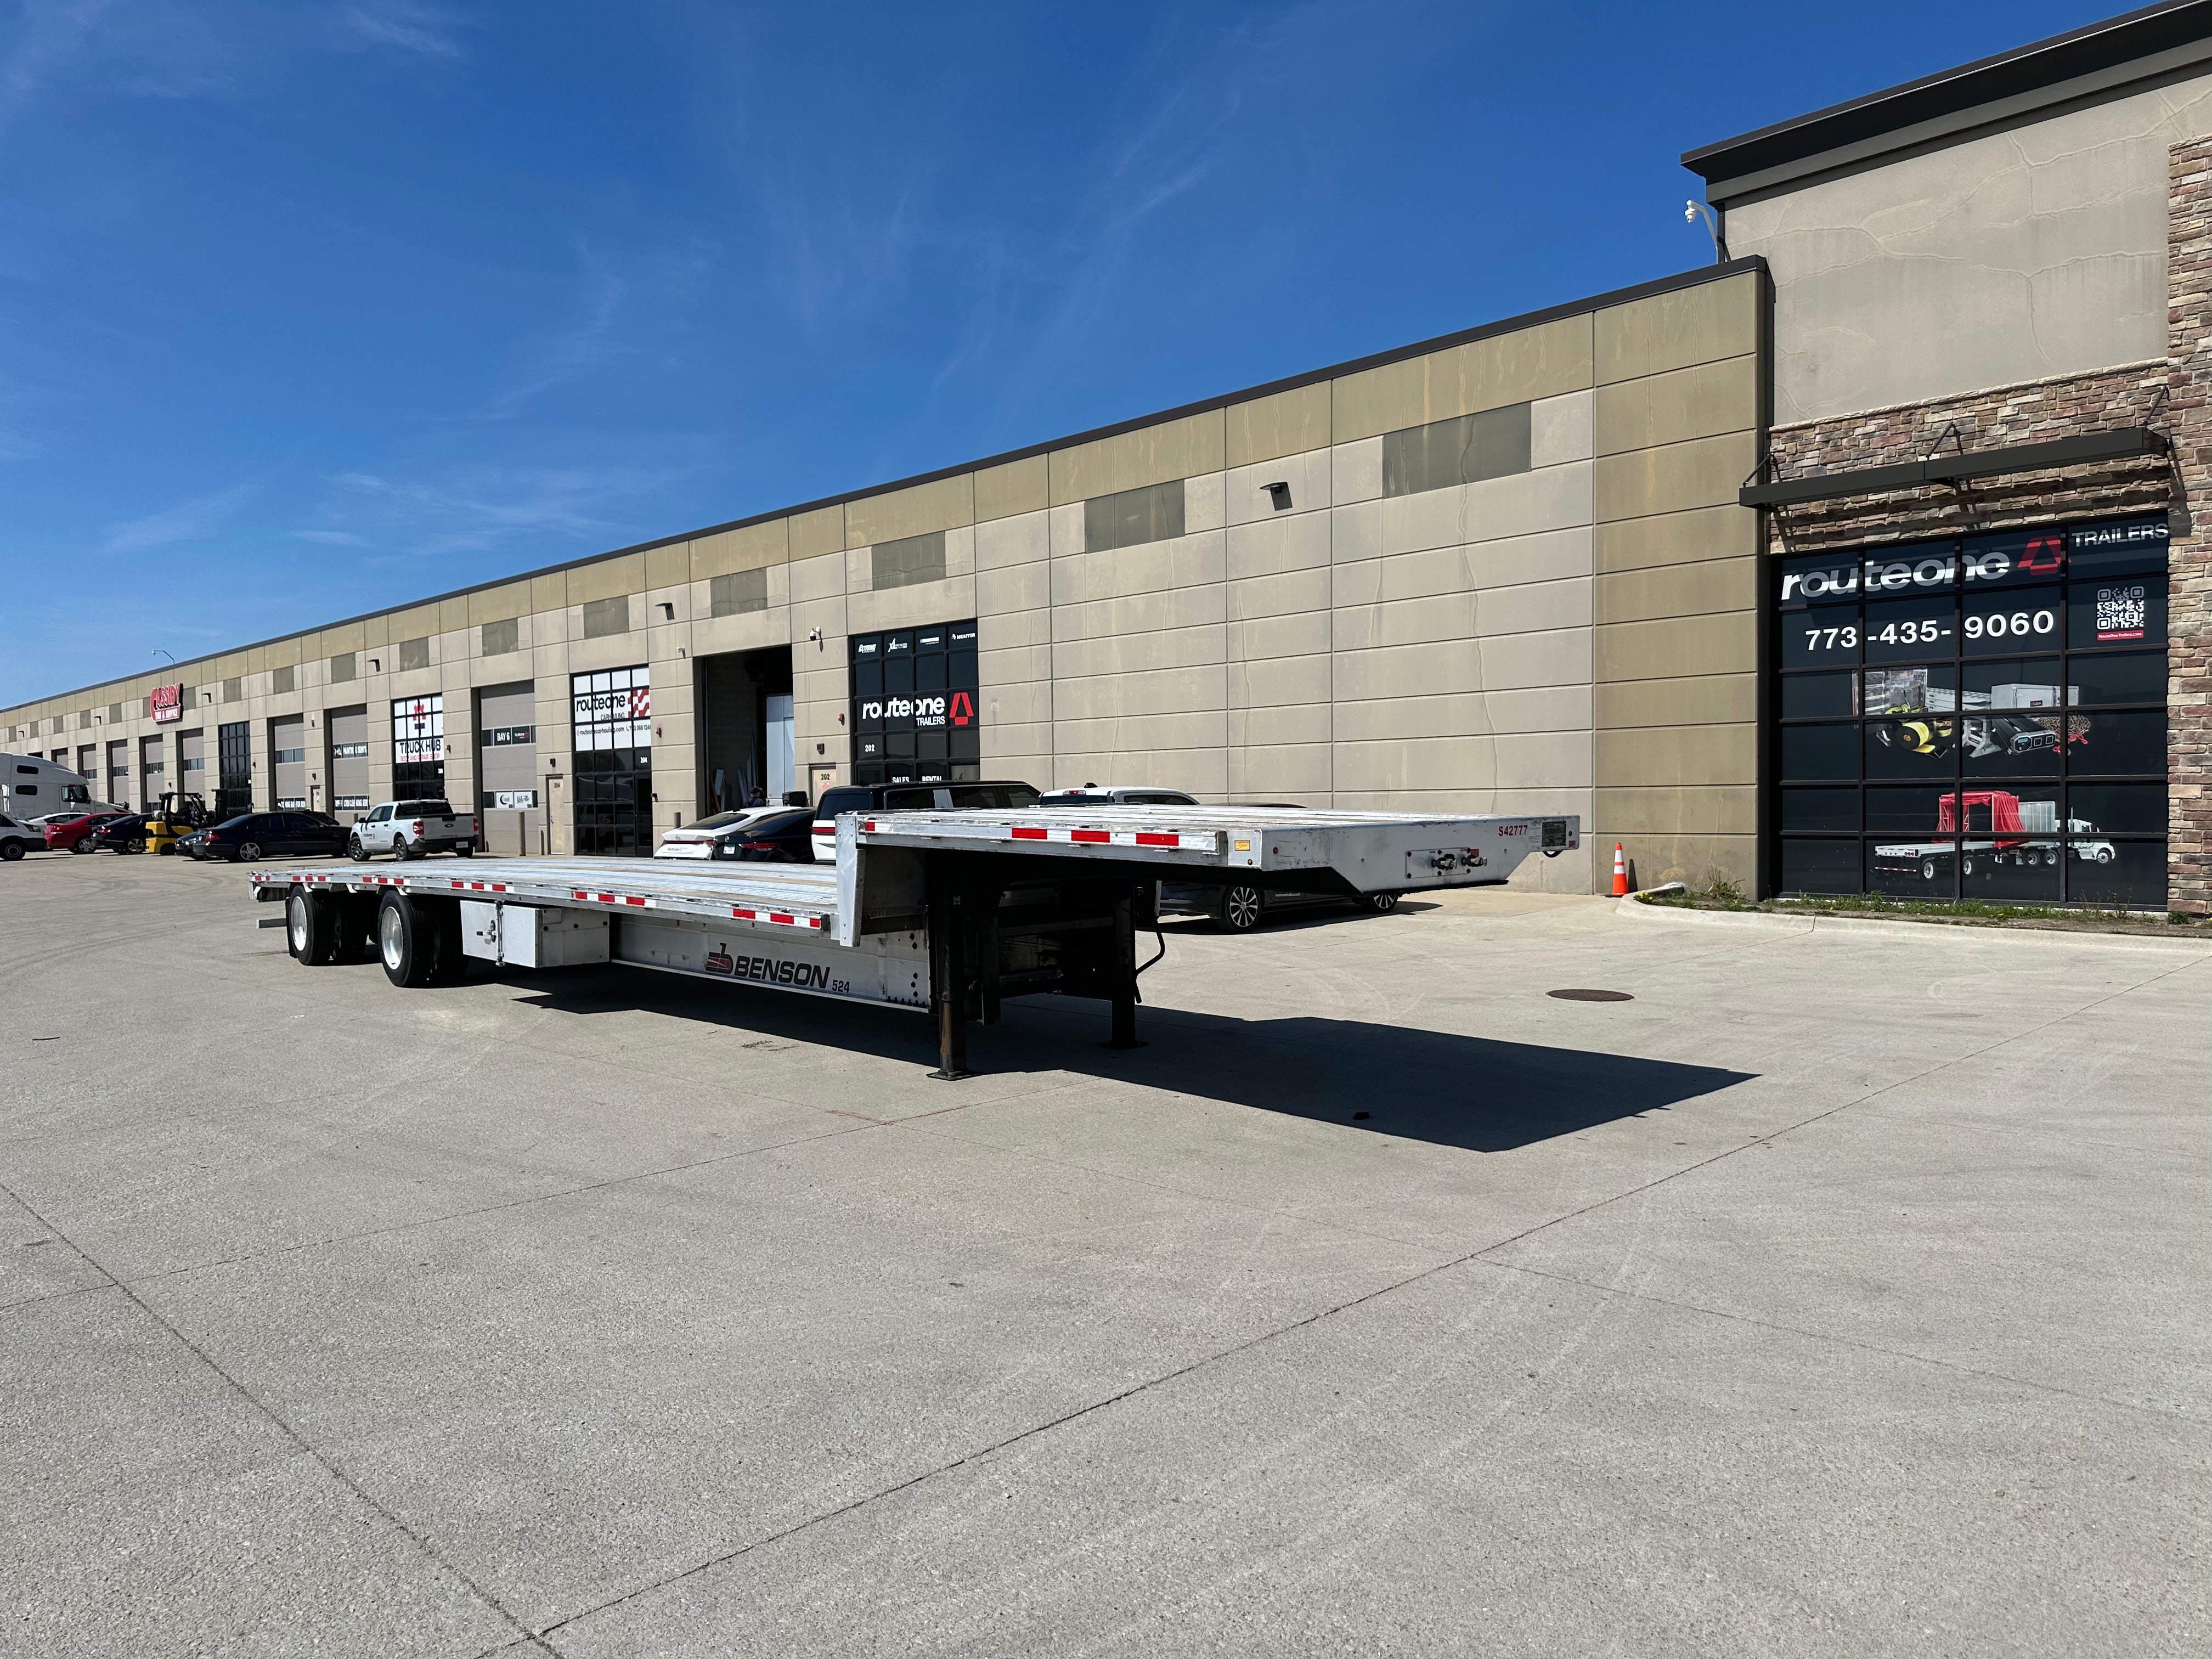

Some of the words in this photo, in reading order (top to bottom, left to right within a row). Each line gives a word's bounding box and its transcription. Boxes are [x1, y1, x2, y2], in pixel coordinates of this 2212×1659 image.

[2072, 523, 2169, 547] TRAILERS
[1781, 552, 2010, 600] routeone
[577, 694, 626, 713] routeone
[862, 697, 945, 720] routeone
[916, 715, 945, 726] TRAILERS
[497, 732, 506, 741] BAY
[506, 731, 510, 741] 6
[399, 741, 424, 754] TRUCK
[426, 739, 441, 752] HUB
[865, 744, 875, 752] 202
[1498, 825, 1528, 837] S42777
[734, 956, 831, 989] BENSON
[832, 979, 850, 993] 524
